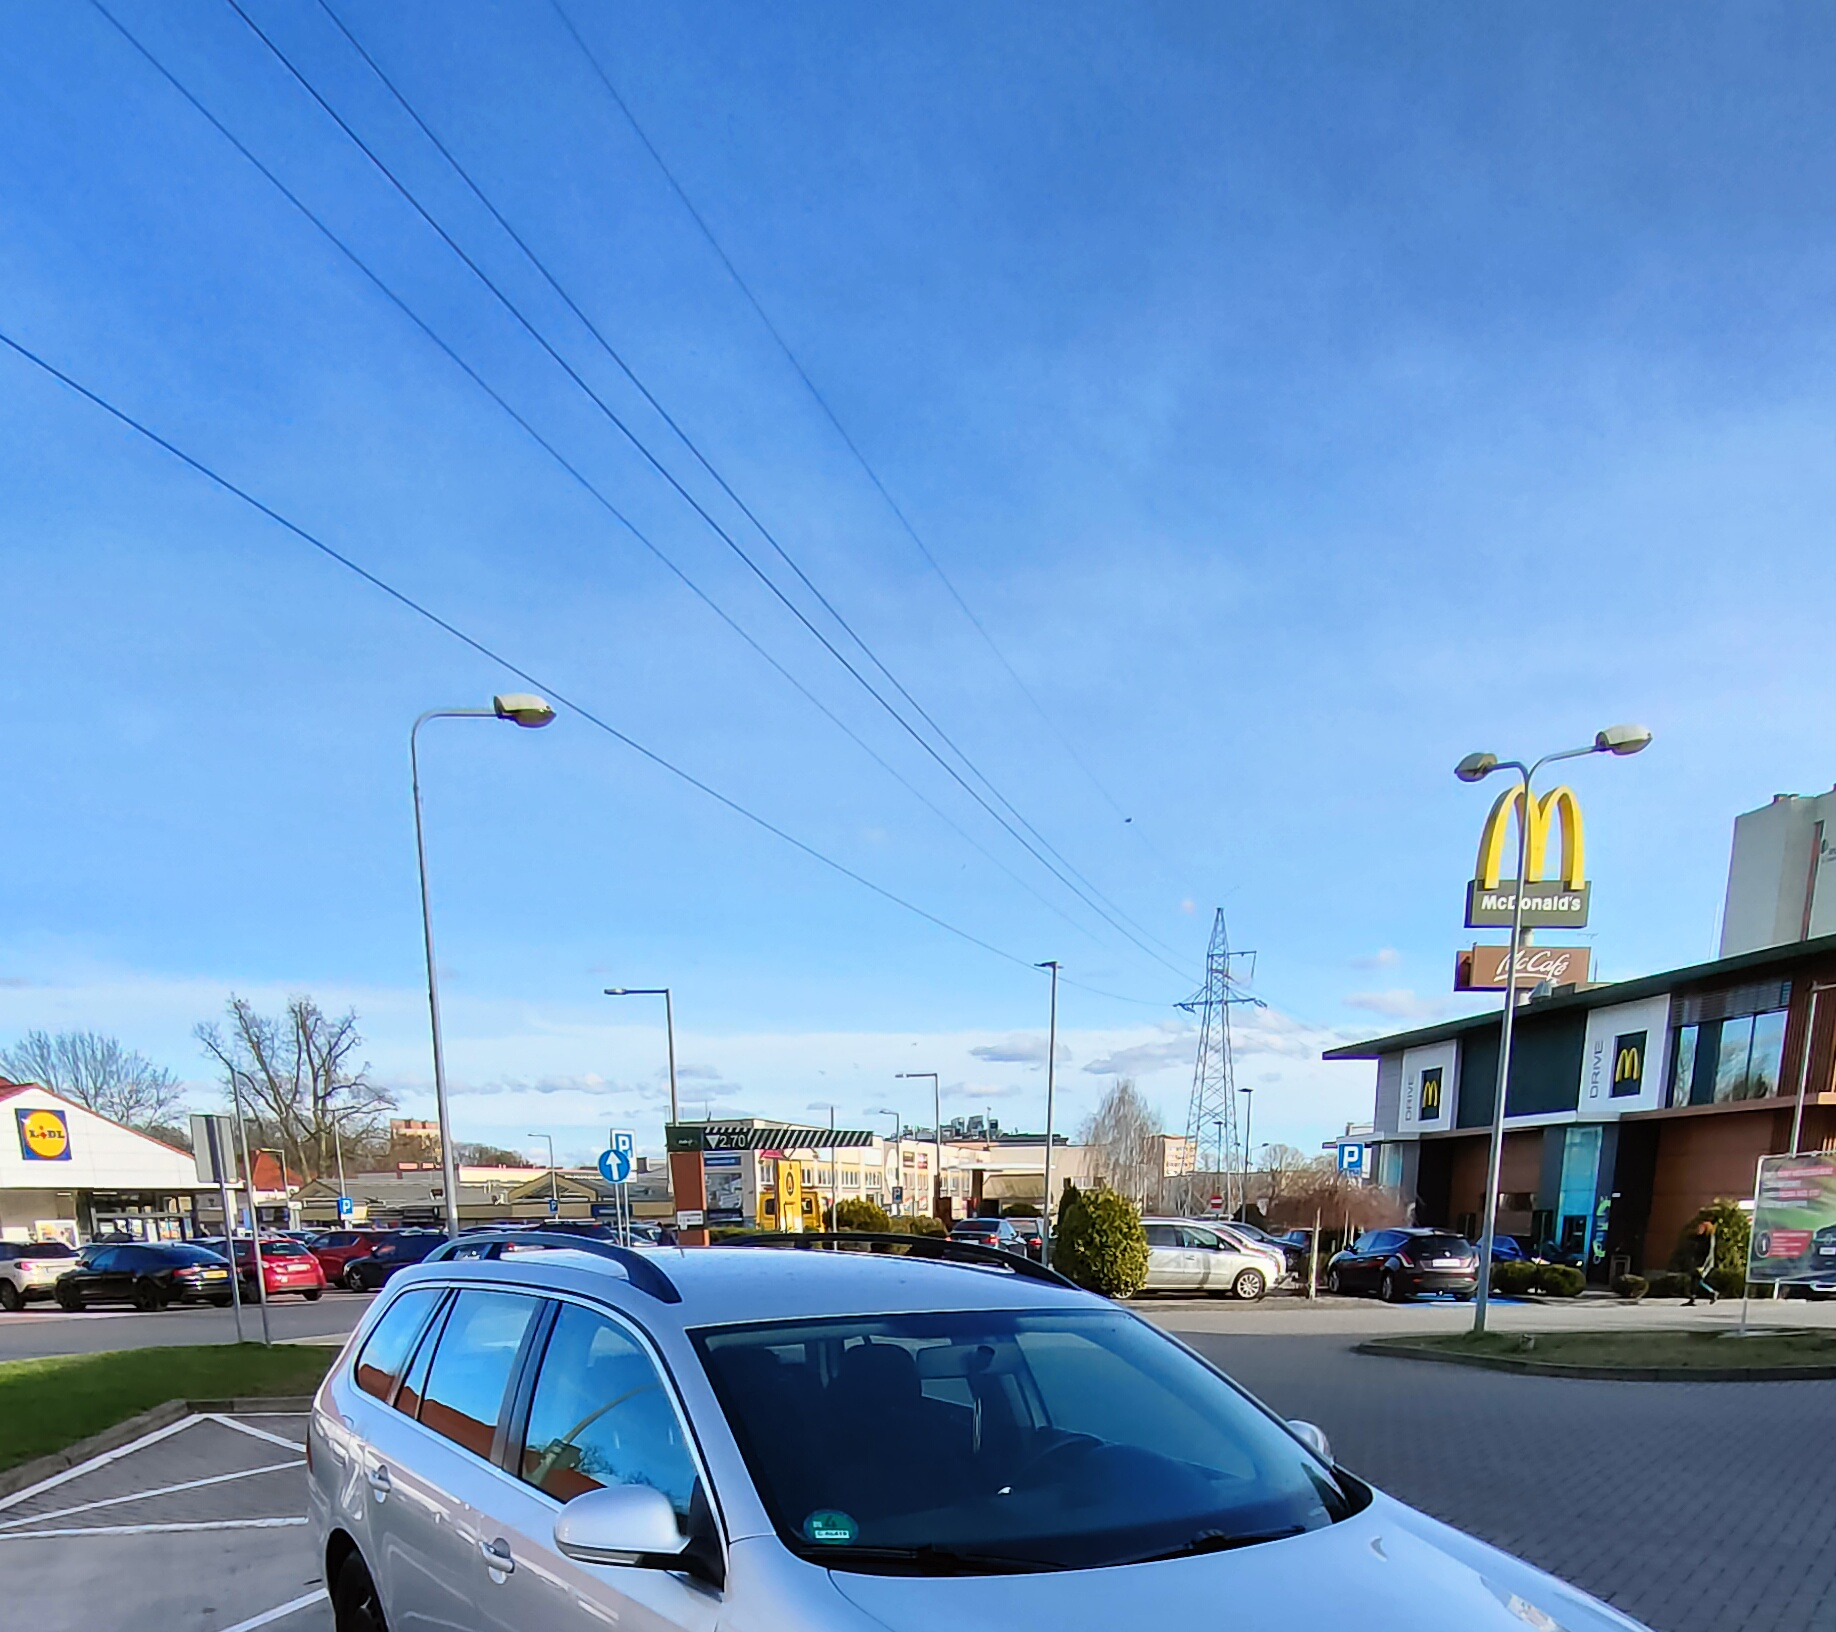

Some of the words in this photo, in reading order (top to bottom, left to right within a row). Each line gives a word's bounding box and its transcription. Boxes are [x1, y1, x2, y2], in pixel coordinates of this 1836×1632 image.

[1481, 895, 1581, 911] McDonald's
[1589, 1039, 1604, 1099] DRIVE
[1405, 1074, 1415, 1121] DRIVE
[719, 1135, 746, 1148] 2.70
[1343, 1146, 1359, 1169] P
[342, 1200, 351, 1213] P
